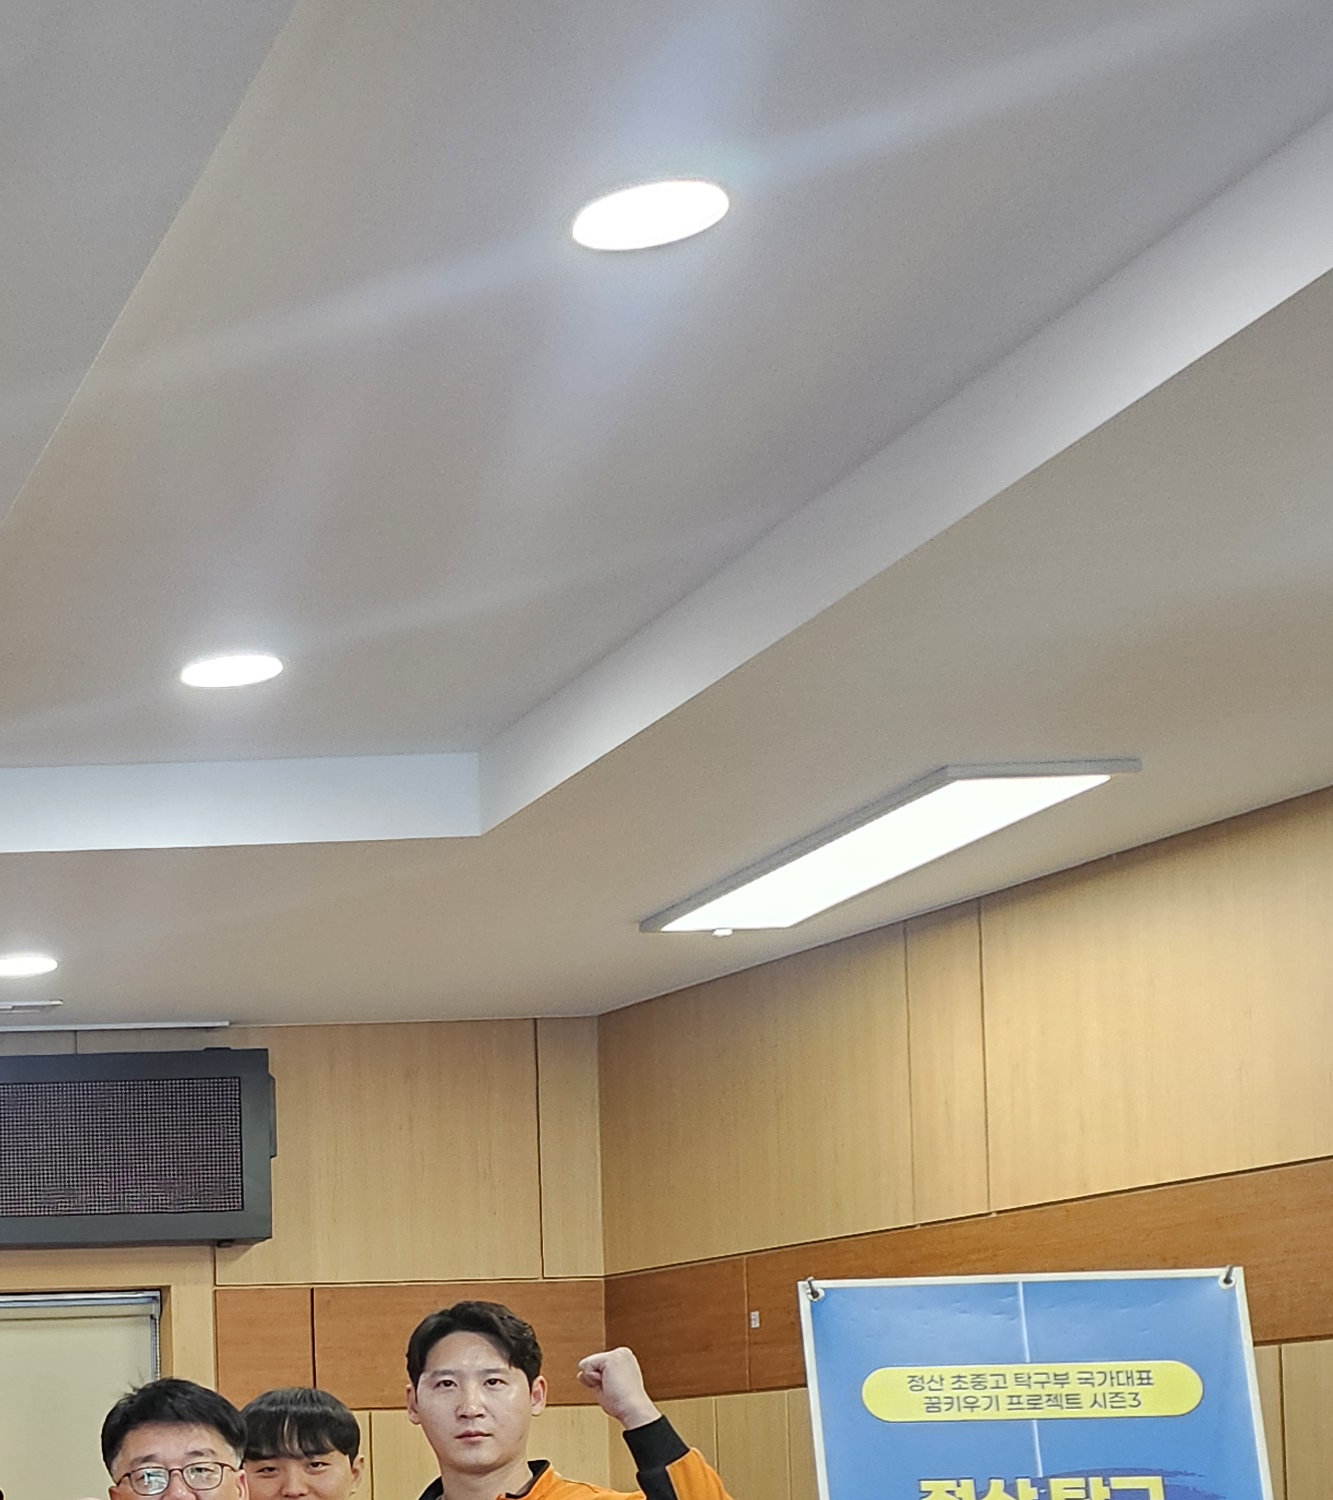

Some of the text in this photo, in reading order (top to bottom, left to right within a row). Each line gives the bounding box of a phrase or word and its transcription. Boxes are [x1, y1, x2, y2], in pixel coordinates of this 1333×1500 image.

[906, 1369, 1155, 1392] 정산 초중고 탁구부 국가대표
[923, 1390, 1143, 1414] 꿈키우기 프로젝트 시즌3
